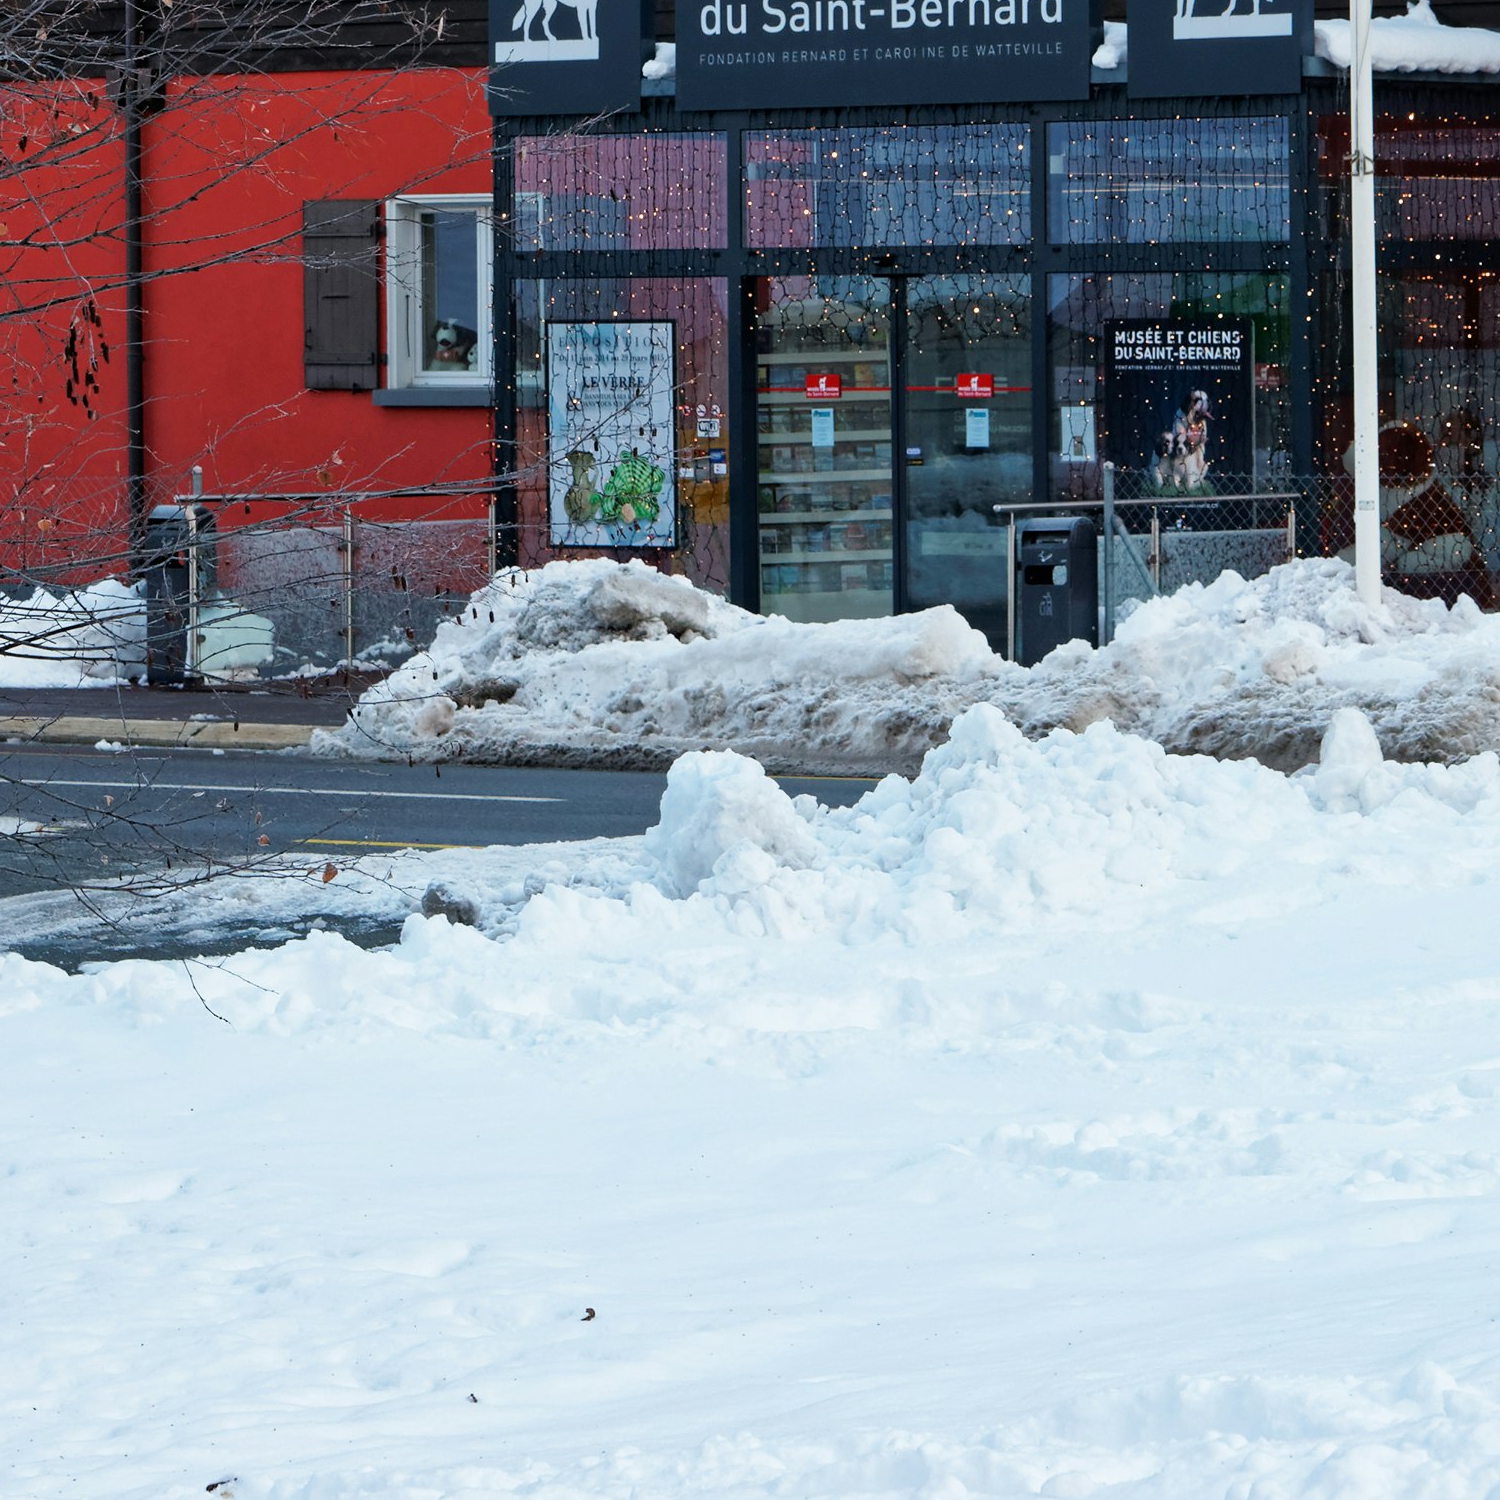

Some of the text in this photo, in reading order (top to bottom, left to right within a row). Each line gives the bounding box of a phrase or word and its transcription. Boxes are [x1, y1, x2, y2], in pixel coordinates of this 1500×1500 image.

[699, 41, 1063, 66] FONDATION BERNARD ET CAROLINE DE WATTEVILLE
[1114, 327, 1240, 344] MUSÉE ET CHIENS
[1115, 346, 1240, 360] DU SAINT-BERNARD
